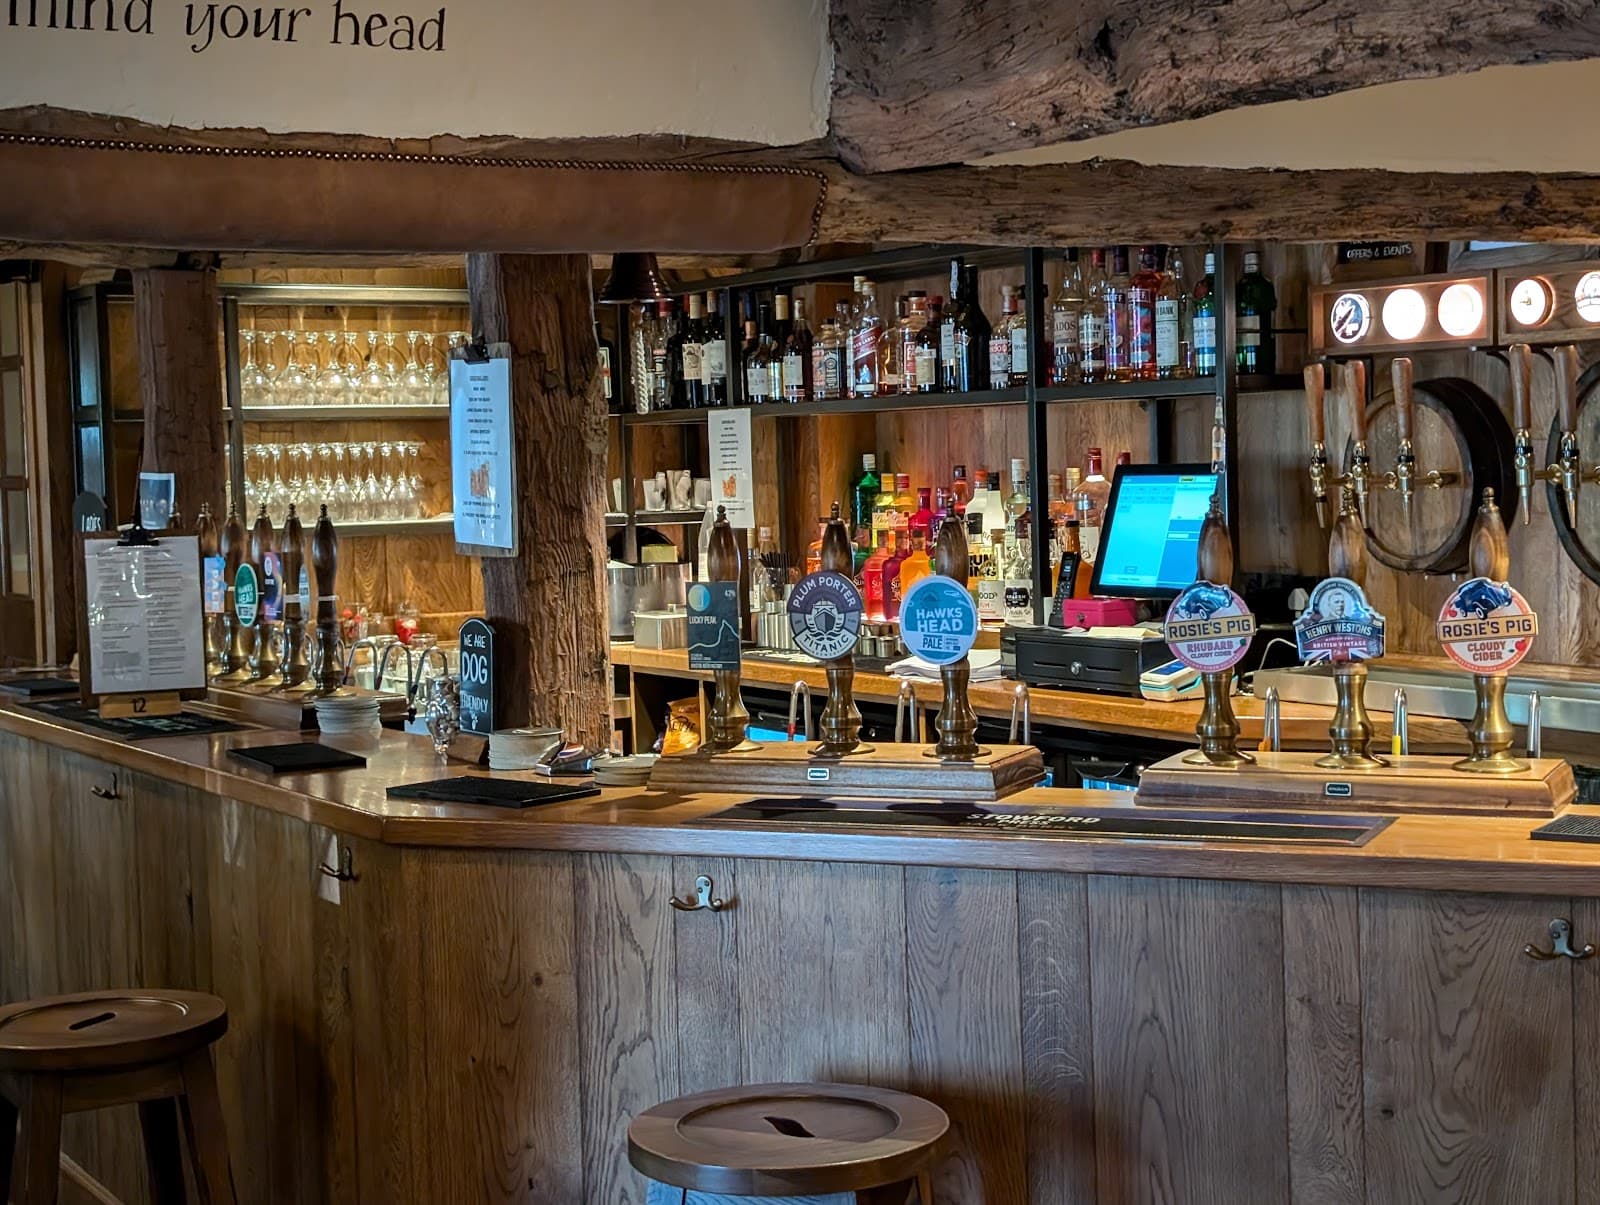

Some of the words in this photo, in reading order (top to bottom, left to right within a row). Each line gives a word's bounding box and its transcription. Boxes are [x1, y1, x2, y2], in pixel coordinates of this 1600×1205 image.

[185, 4, 311, 53] your
[329, 0, 447, 51] head
[1383, 244, 1412, 257] EVENTS
[792, 578, 817, 608] PLUM
[818, 576, 857, 607] PORTER
[688, 615, 703, 625] LUCKY
[704, 615, 717, 625] PEAK
[916, 607, 963, 619] HAWKS
[917, 618, 964, 633] HEAD
[1168, 621, 1222, 638] ROSIE'S
[1227, 619, 1251, 633] PIG
[1305, 624, 1333, 639] HENRY
[1333, 622, 1373, 636] WESTONS
[1442, 621, 1500, 638] ROSIE'S
[1506, 619, 1532, 633] PIG
[463, 634, 473, 647] WE
[474, 634, 487, 649] ARE
[803, 633, 849, 653] TITANIC
[922, 637, 943, 650] PALE
[1186, 641, 1234, 653] RHUBARB
[1467, 641, 1506, 652] CLOUDY
[1473, 652, 1503, 661] CIDER
[462, 651, 488, 685] DOG
[131, 698, 147, 713] 12
[460, 690, 489, 713] FRIENDLY
[966, 813, 1101, 824] STOWFORD
